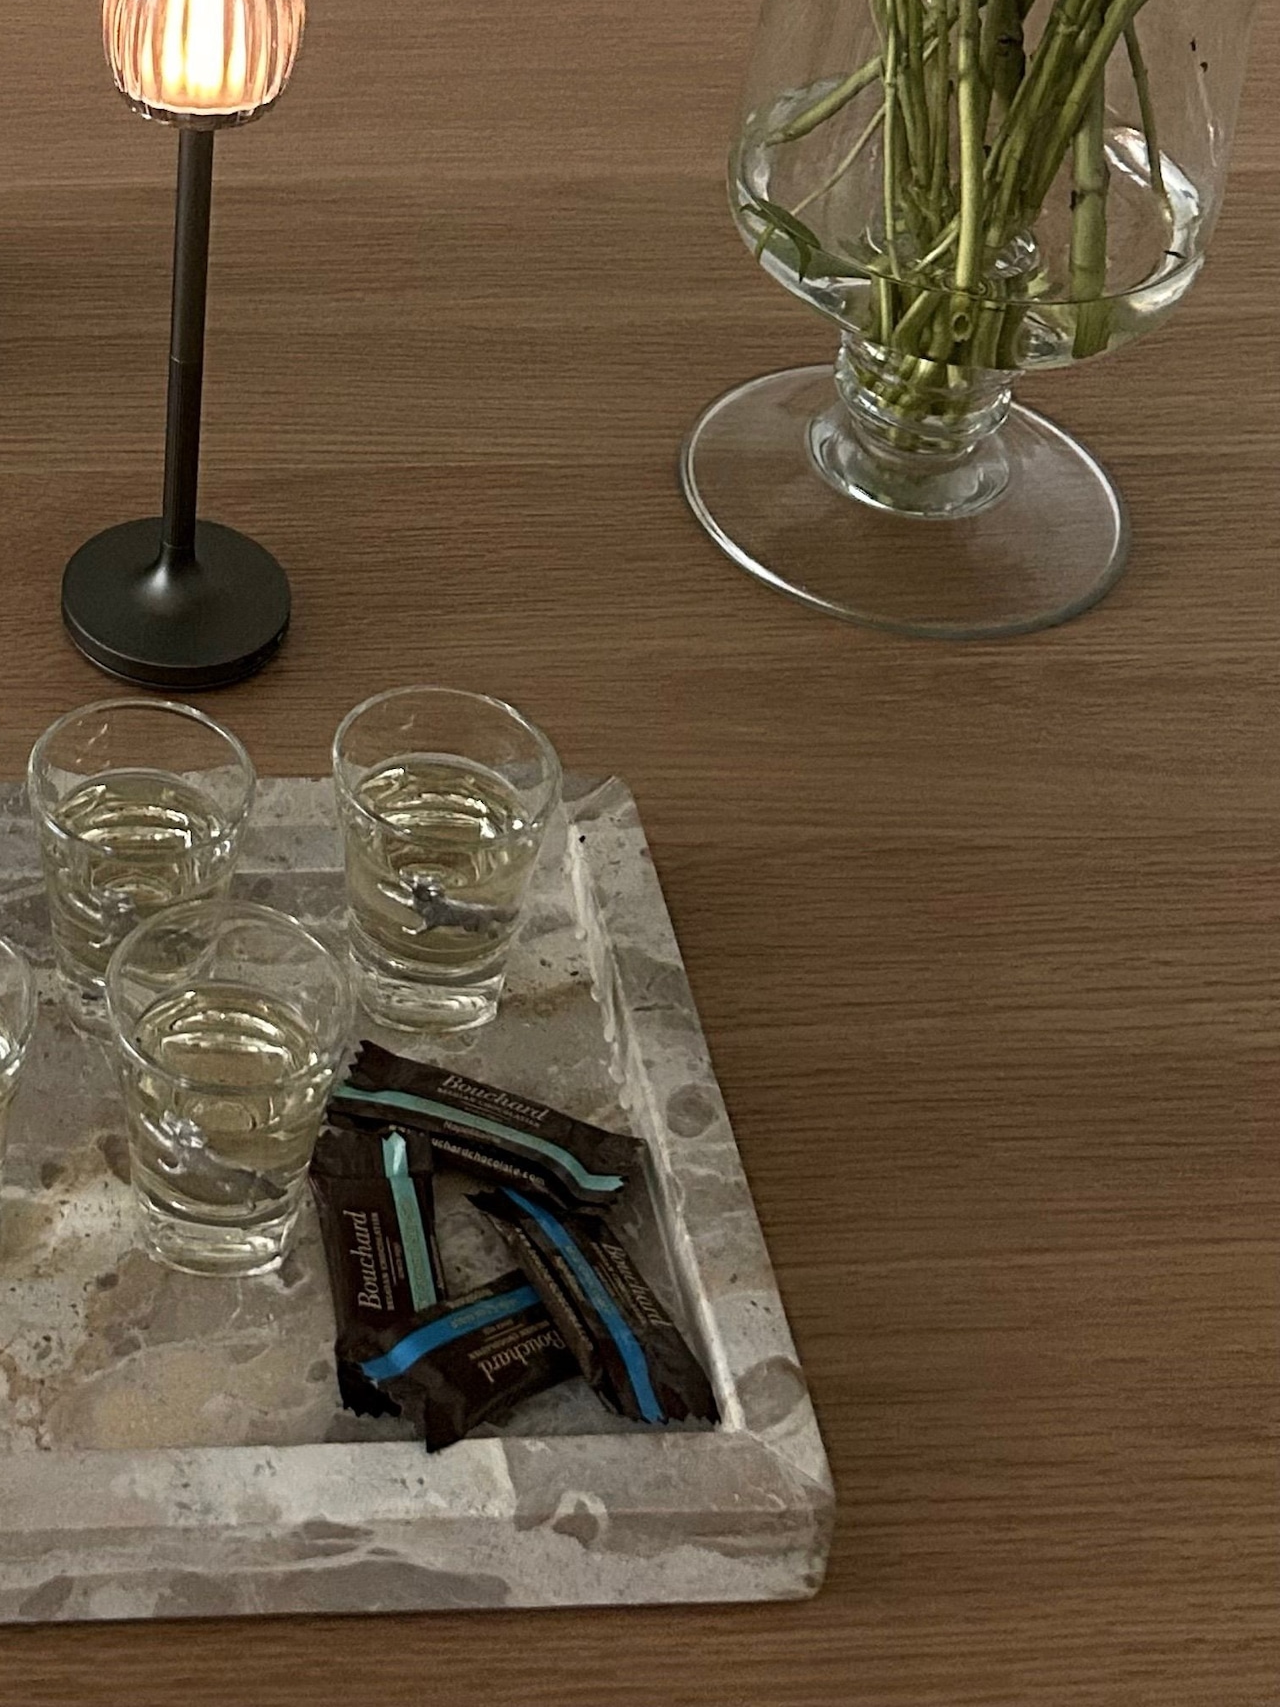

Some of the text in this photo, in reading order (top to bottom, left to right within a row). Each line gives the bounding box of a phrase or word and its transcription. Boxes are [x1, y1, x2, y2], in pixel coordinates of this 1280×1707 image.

[442, 1075, 550, 1122] Bouchard
[431, 1137, 546, 1186] uchardchocolate.com
[343, 1210, 382, 1310] Bouchard
[602, 1244, 673, 1327] Bouchard
[478, 1330, 566, 1383] Bouchard
